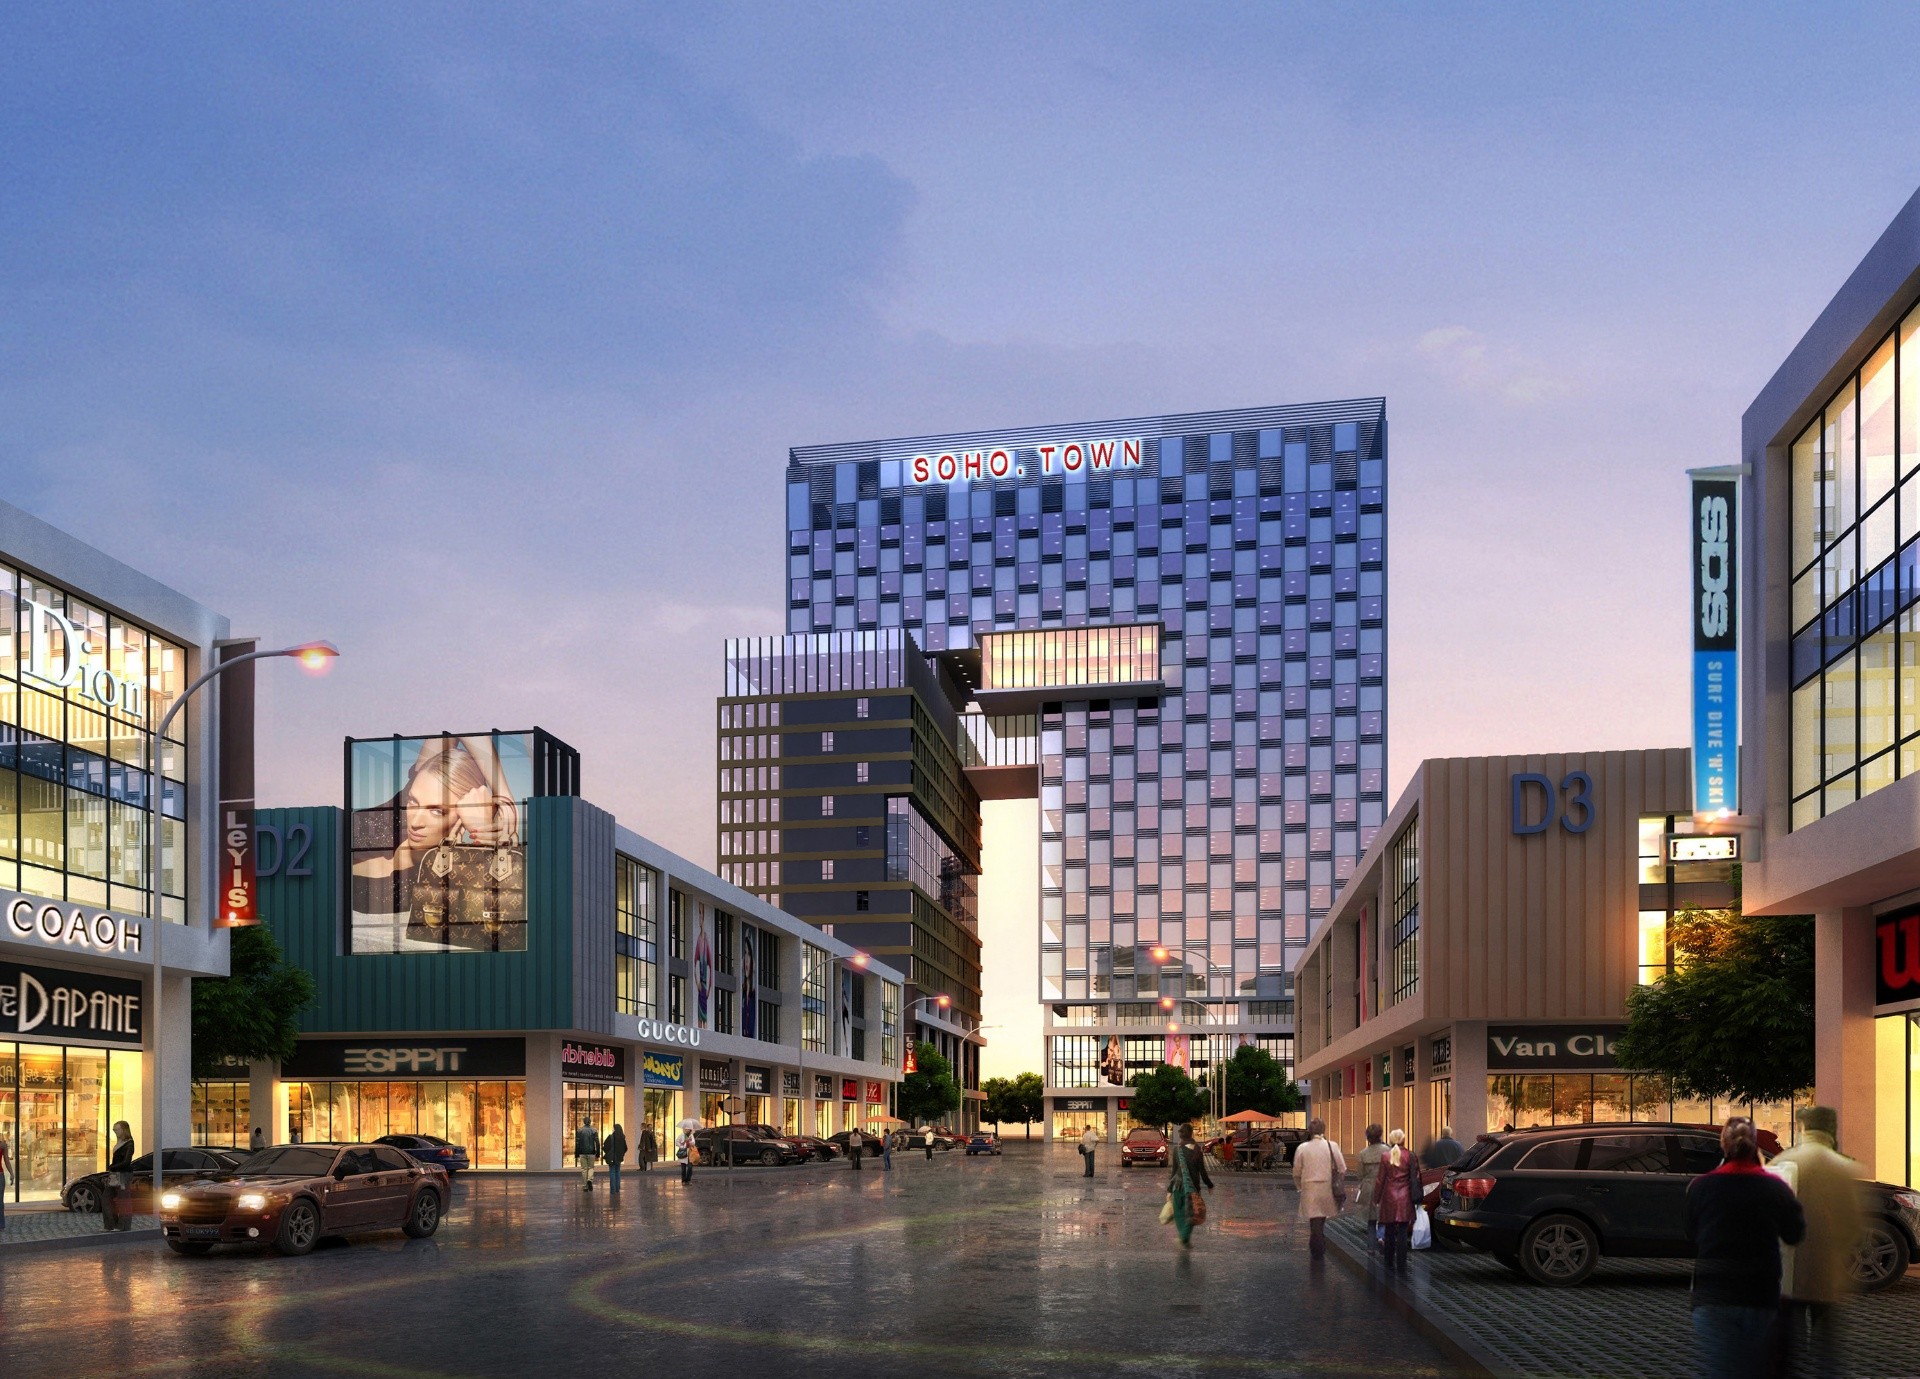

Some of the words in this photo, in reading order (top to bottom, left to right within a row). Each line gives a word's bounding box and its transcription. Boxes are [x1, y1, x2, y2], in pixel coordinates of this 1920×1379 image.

[1040, 440, 1140, 472] TOWN
[22, 598, 142, 718] Dion
[1708, 661, 1722, 703] SURF
[1708, 712, 1722, 748] DIVE
[1512, 771, 1595, 835] D3
[1709, 776, 1724, 803] SKI
[256, 823, 313, 876] D2
[8, 899, 141, 953] COAOH
[638, 1019, 700, 1046] GUCCU
[1490, 1036, 1556, 1056] Van
[344, 1048, 467, 1072] ESPPIT
